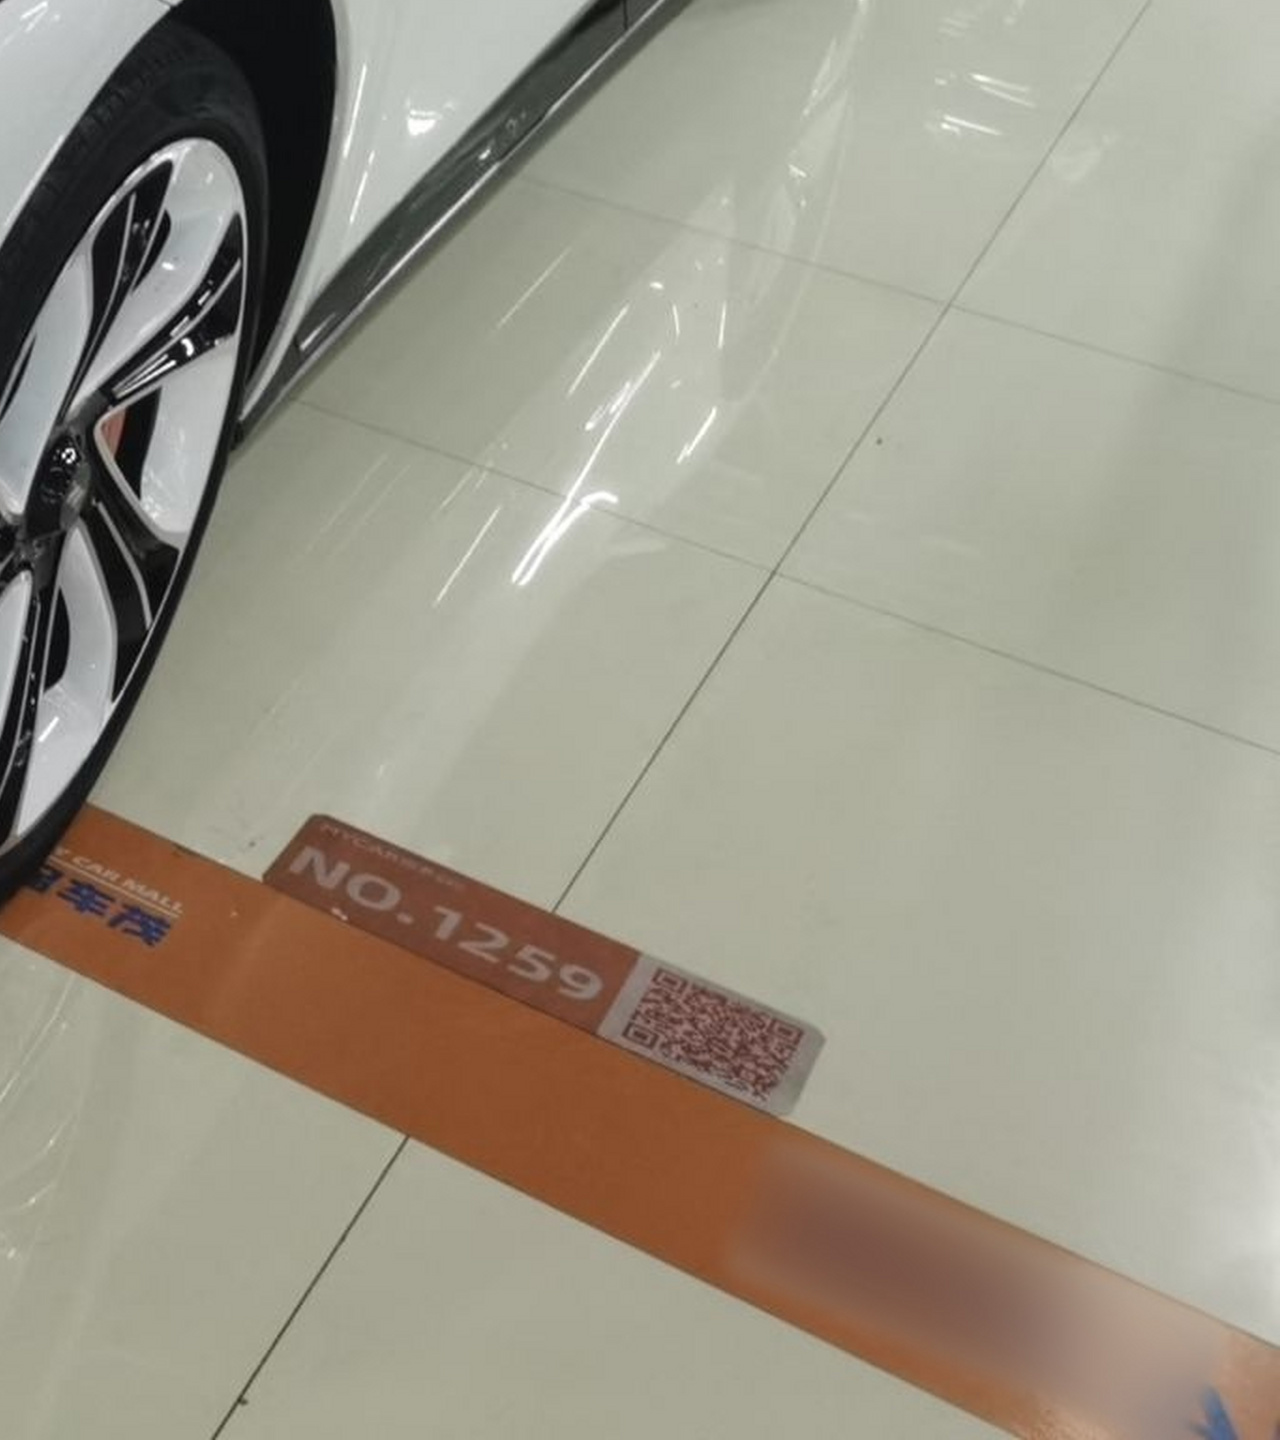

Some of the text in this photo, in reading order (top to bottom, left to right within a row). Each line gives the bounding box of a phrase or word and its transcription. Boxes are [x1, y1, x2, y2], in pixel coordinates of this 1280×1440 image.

[72, 857, 121, 883] CAR
[122, 877, 184, 914] MALL
[288, 844, 604, 1003] NO.1259
